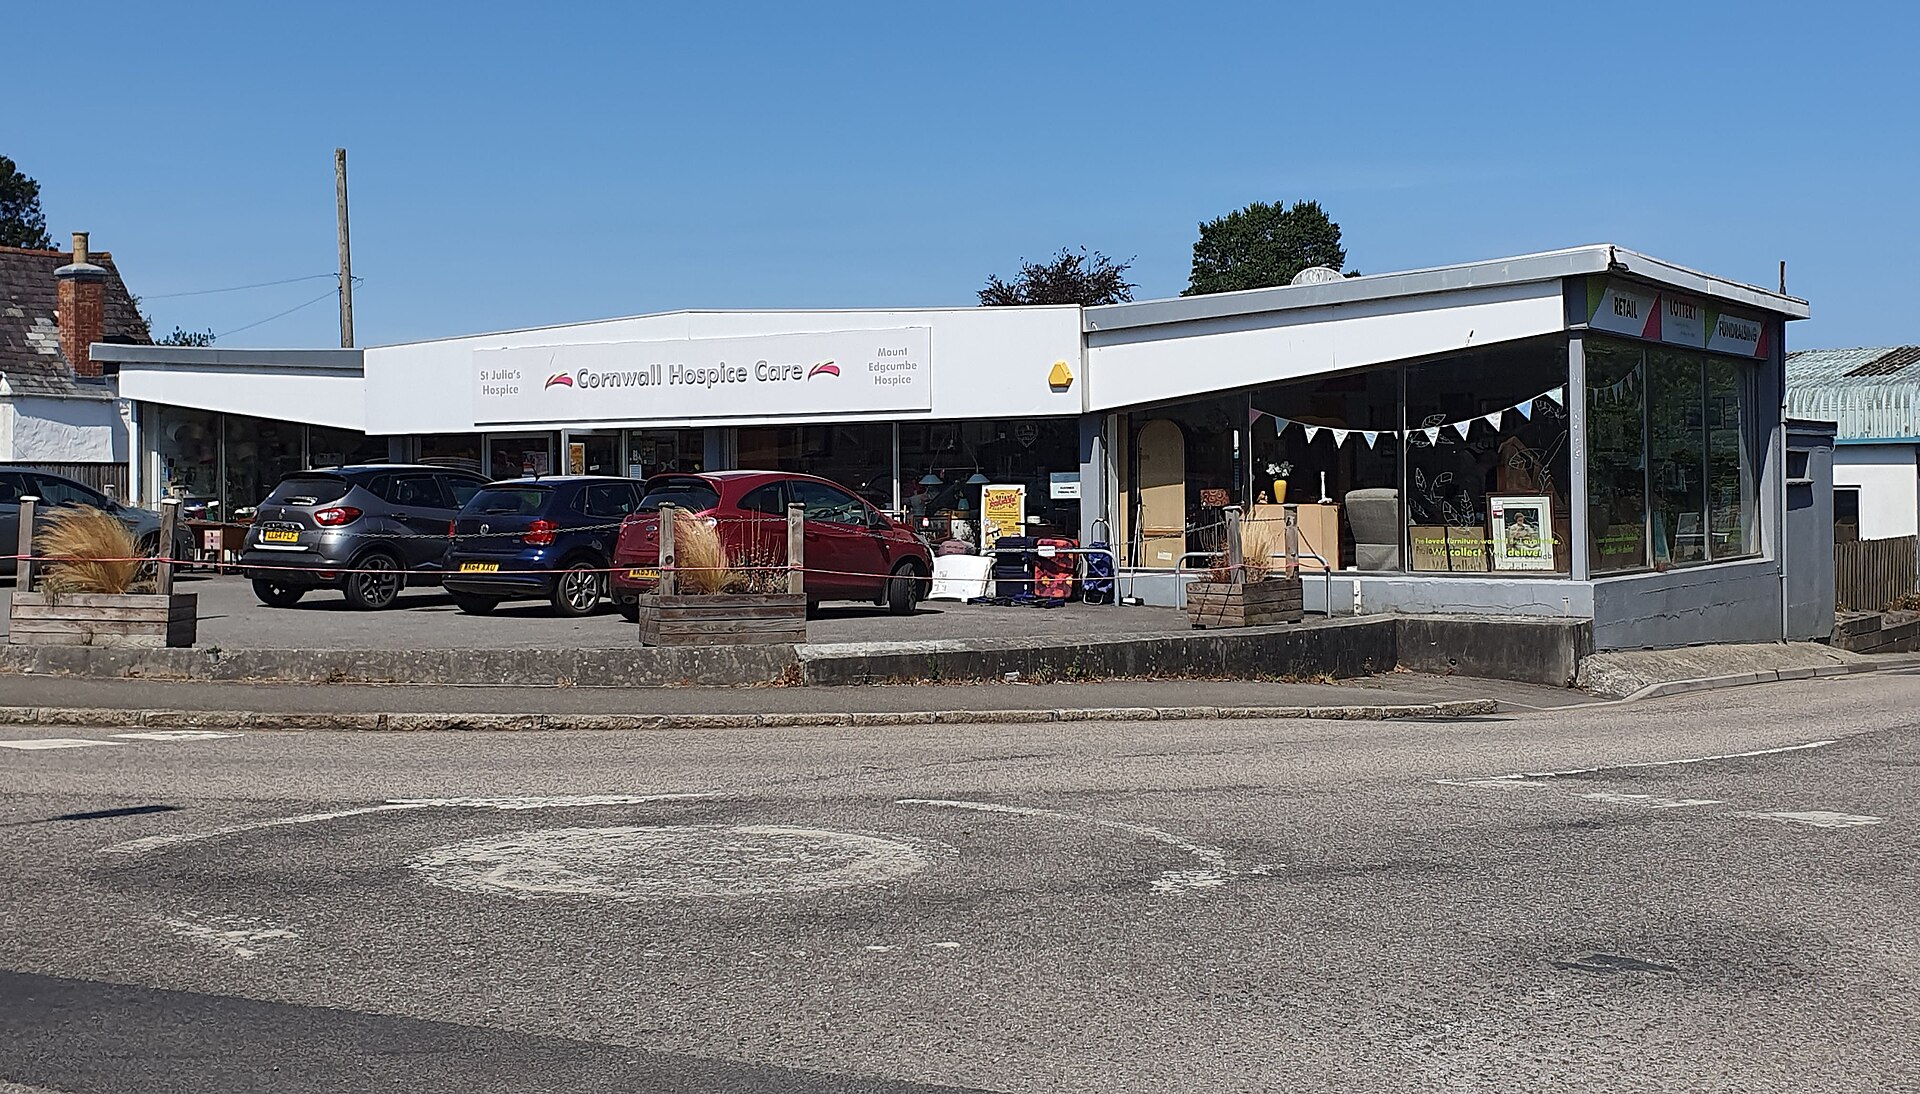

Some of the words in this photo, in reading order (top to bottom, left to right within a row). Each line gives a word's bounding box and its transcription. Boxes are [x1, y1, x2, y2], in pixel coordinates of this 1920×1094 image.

[1614, 296, 1638, 320] RETAIL
[1669, 299, 1697, 320] LOTTERY
[1719, 320, 1758, 343] FUNDRAISING
[877, 347, 908, 358] Mount
[868, 360, 917, 374] Edgcumbe
[480, 370, 490, 381] St
[491, 369, 521, 381] Julia's
[577, 364, 662, 389] Cornwall
[668, 361, 748, 389] Hospice
[754, 360, 803, 382] Care
[874, 374, 912, 387] Hospice
[482, 383, 519, 397] Hospice
[1449, 546, 1482, 557] collect
[1507, 547, 1542, 557] deliver
